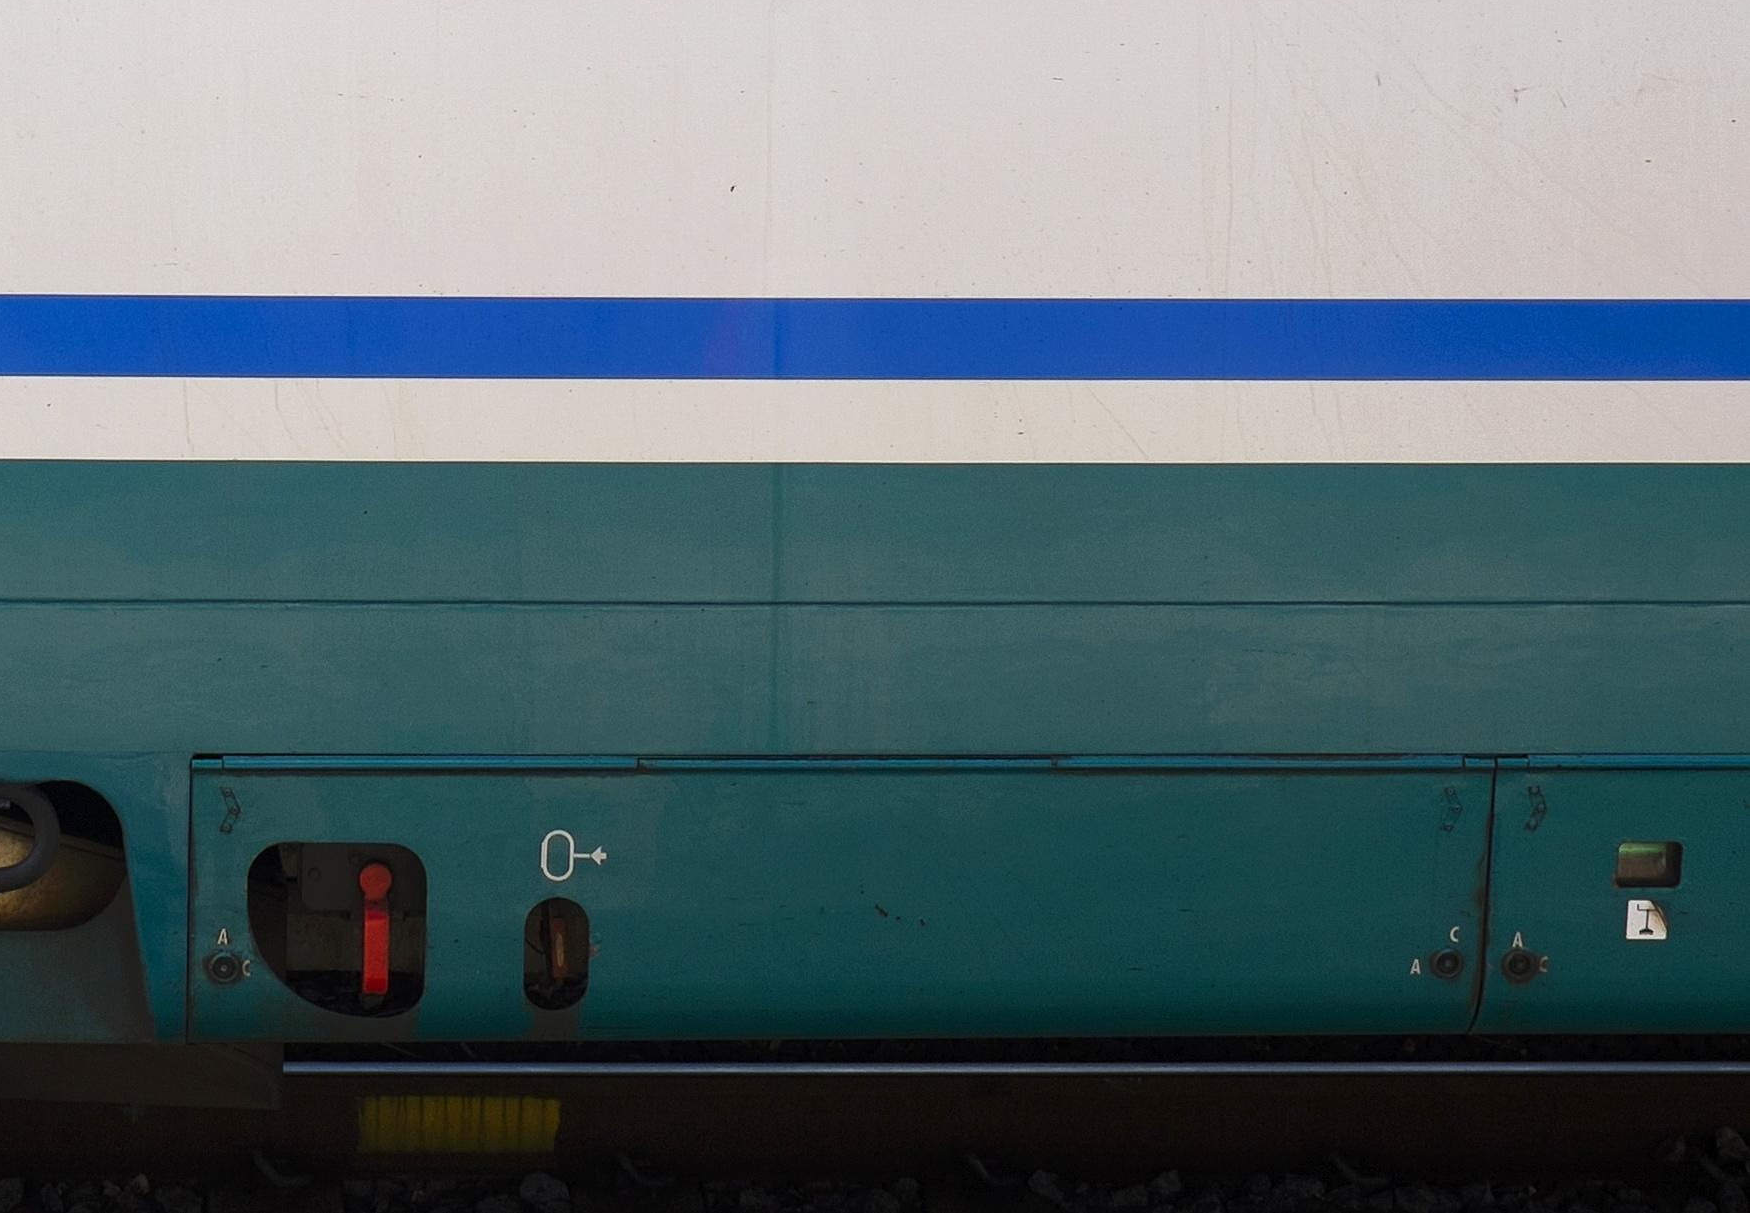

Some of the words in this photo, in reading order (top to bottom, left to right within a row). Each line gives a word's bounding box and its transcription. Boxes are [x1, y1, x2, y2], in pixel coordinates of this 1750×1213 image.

[217, 928, 228, 946] A
[1450, 926, 1460, 943] C
[1512, 931, 1523, 948] A
[1410, 958, 1421, 975] A
